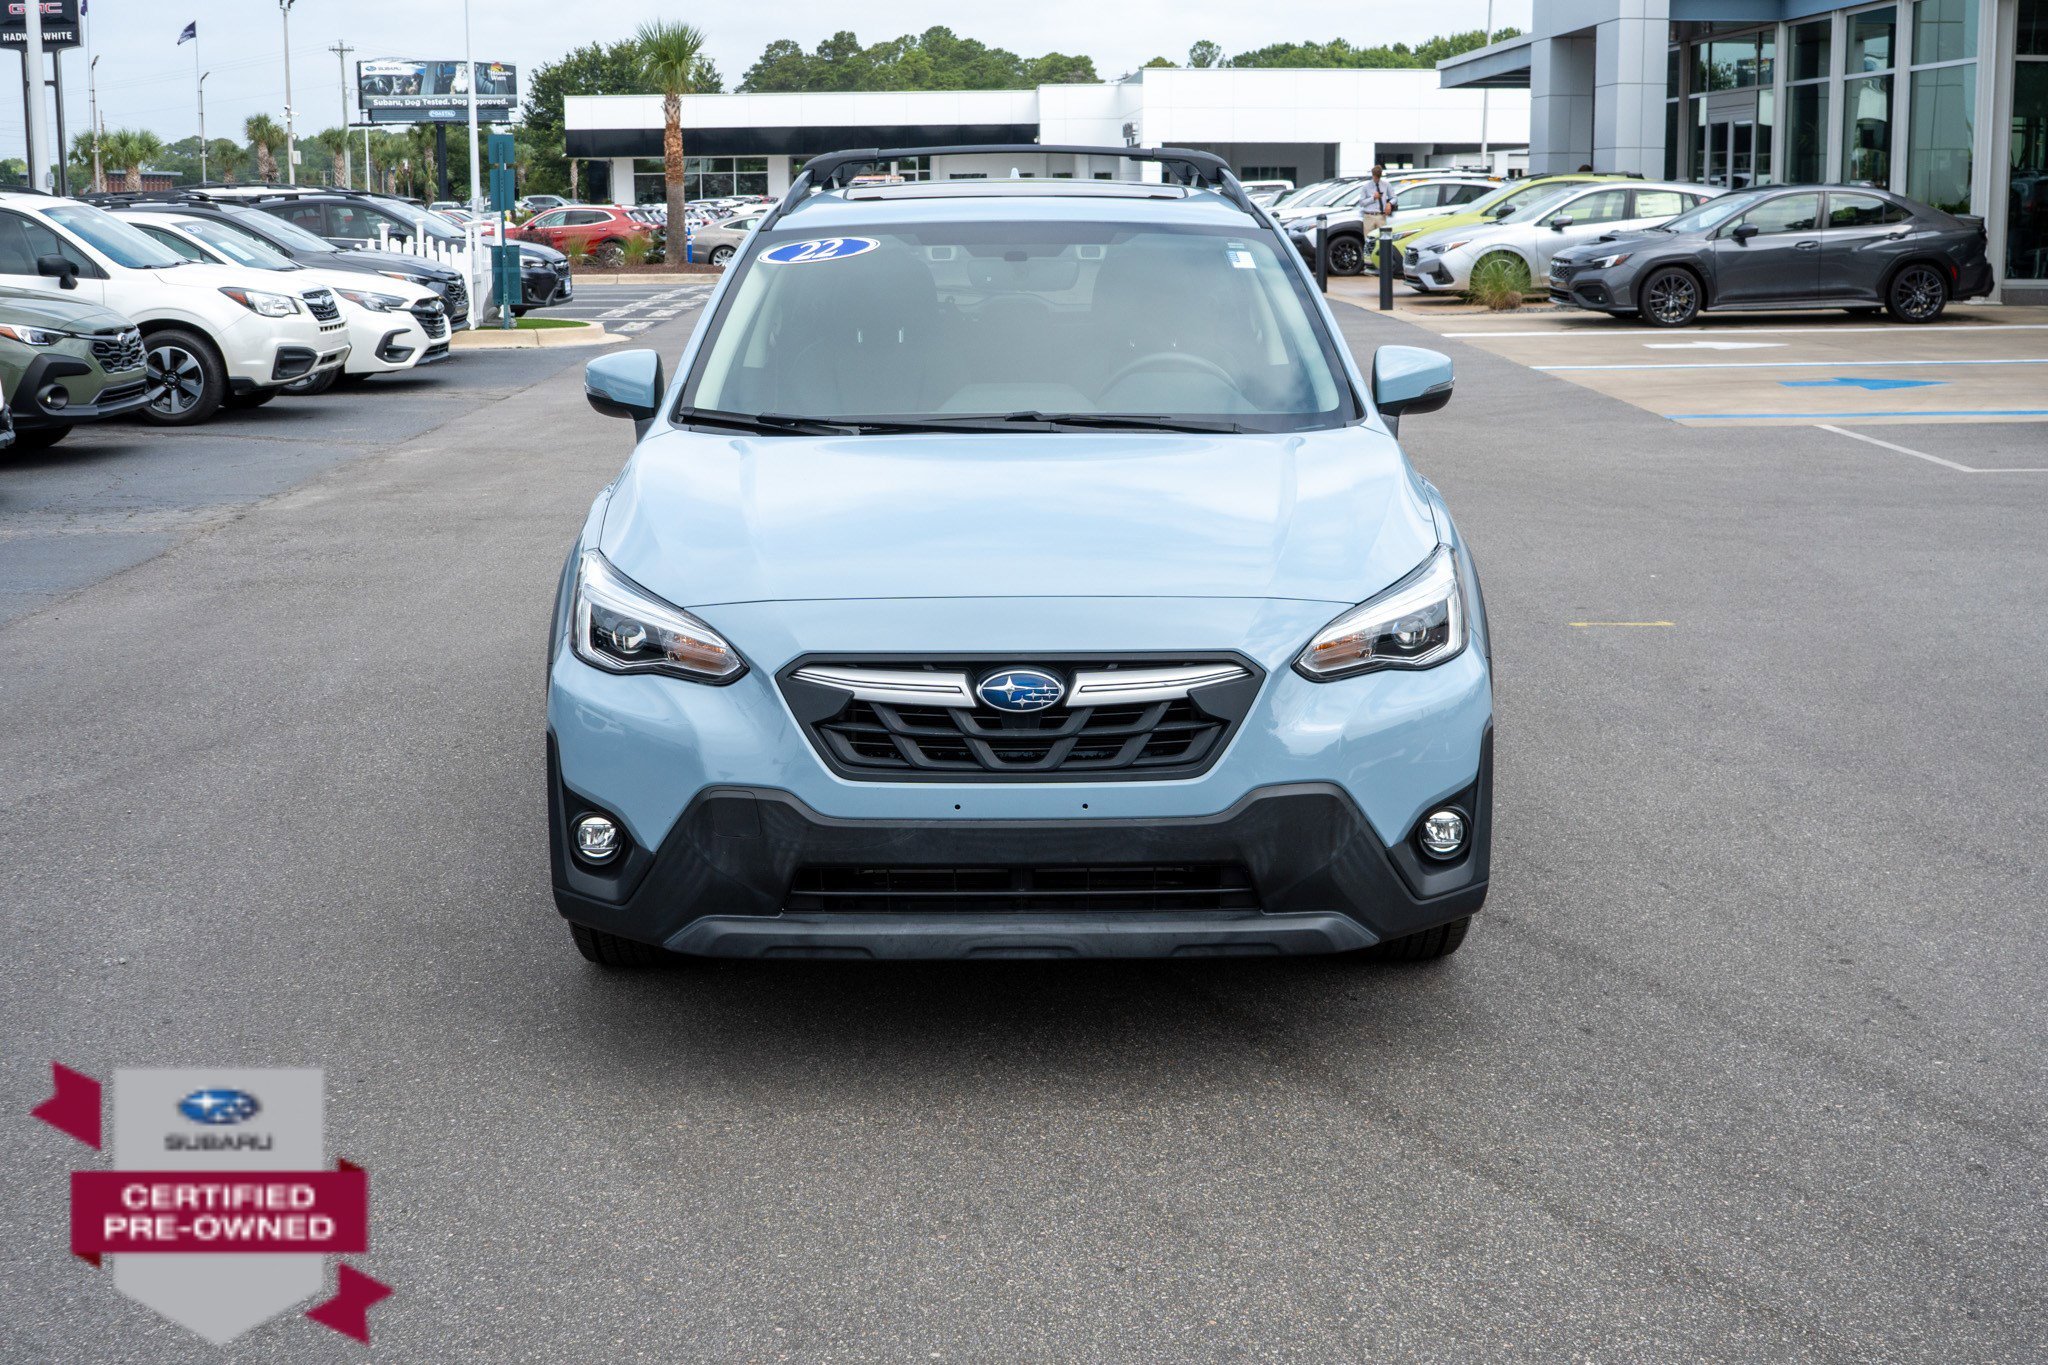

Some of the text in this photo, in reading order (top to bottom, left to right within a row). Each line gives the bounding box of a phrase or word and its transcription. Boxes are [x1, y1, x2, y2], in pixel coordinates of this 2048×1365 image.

[9, 2, 63, 15] GC
[2, 31, 73, 42] HADW-WHITE
[373, 98, 403, 107] Subaru,
[404, 98, 421, 107] Dog
[422, 98, 450, 106] Tested.
[452, 98, 468, 107] Dog
[788, 238, 844, 262] 22
